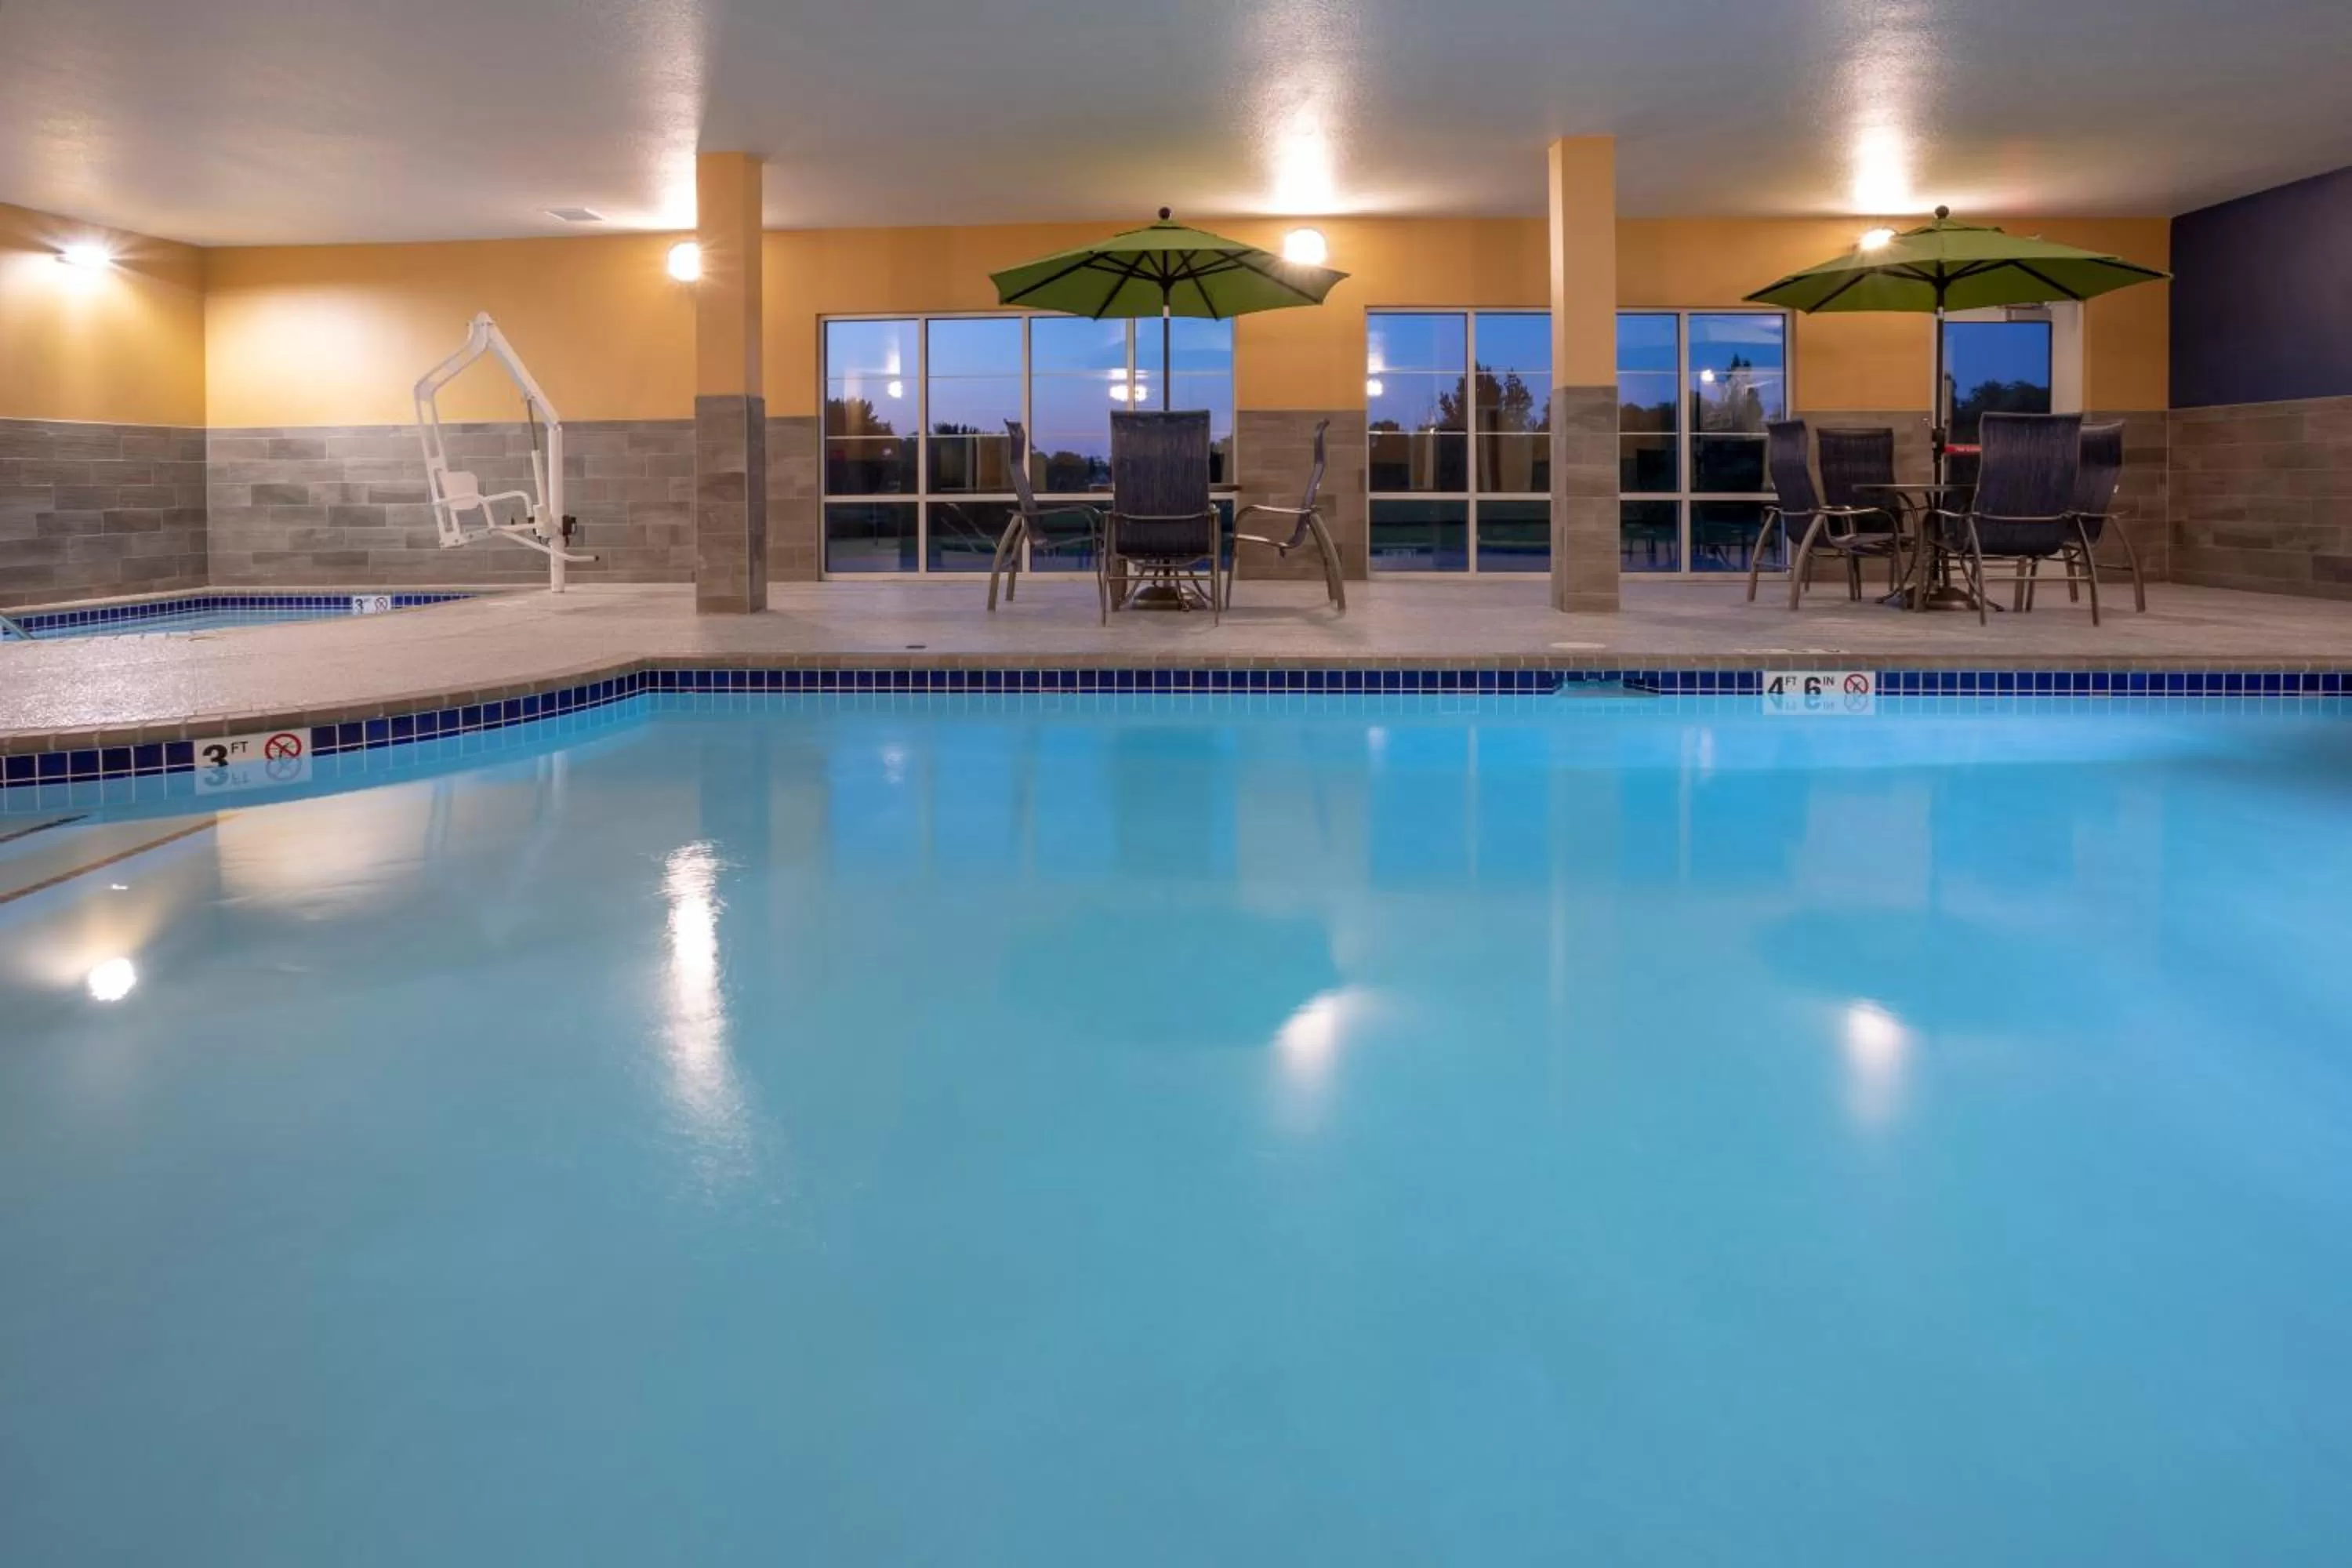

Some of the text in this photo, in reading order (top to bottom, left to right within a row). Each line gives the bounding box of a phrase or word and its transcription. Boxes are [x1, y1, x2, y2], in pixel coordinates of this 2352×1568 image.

[1767, 676, 1835, 695] 4 FT 6 IN
[202, 741, 249, 768] 3 FT
